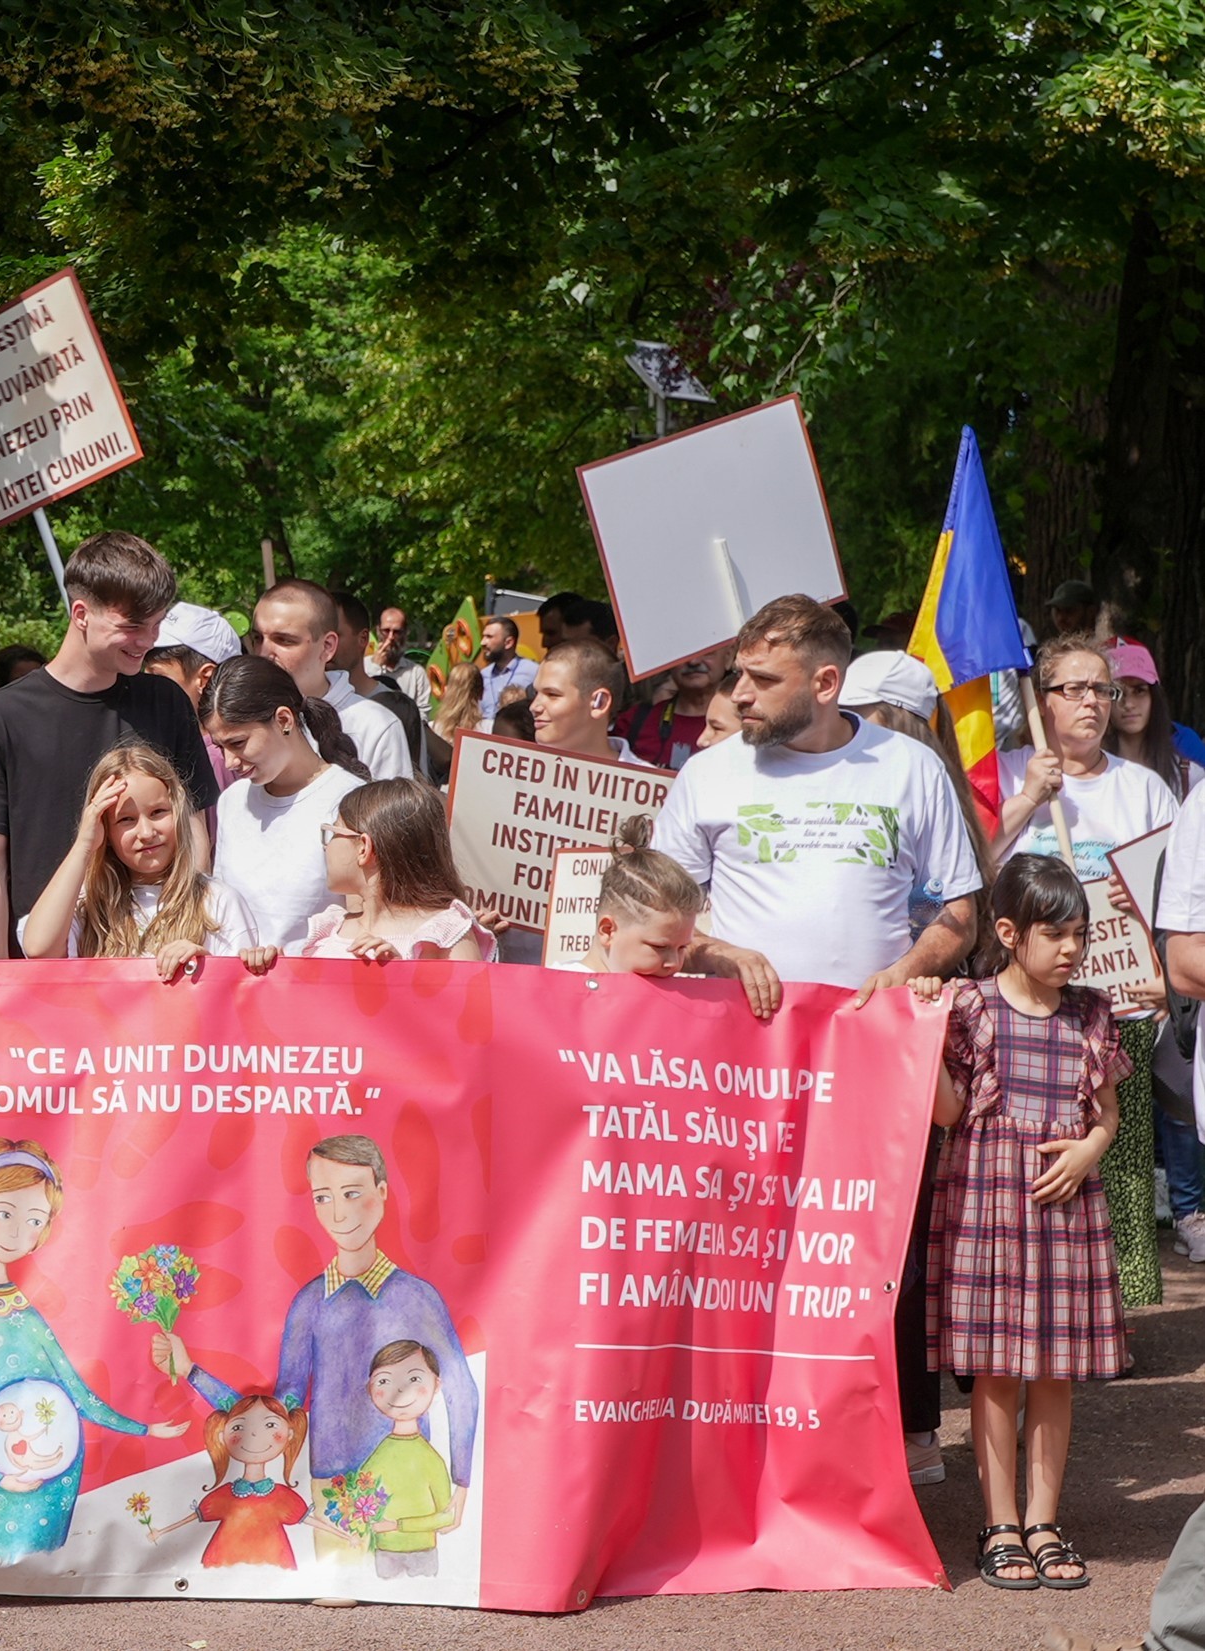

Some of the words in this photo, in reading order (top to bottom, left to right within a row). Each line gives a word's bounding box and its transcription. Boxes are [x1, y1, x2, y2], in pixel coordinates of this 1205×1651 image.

[49, 392, 94, 431] PRIN
[47, 431, 128, 485] CUNUNII.
[482, 749, 545, 783] CRED
[553, 757, 579, 791] ÎN
[587, 770, 667, 809] VIITOR
[513, 792, 618, 835] FAMILIEI
[491, 823, 603, 858] INSTI
[573, 859, 614, 876] CONL
[560, 935, 594, 952] TREB
[1089, 916, 1131, 944] ESTE
[73, 1048, 96, 1075] A
[104, 1045, 174, 1074] UNIT
[184, 1045, 363, 1074] DUMNEZEU
[630, 1049, 708, 1092] LĂSA
[715, 1062, 793, 1100] OMUL
[794, 1069, 834, 1103] PE
[92, 1079, 128, 1114] SĂ
[137, 1083, 180, 1113] NU
[582, 1101, 677, 1142] TATĂL
[685, 1106, 737, 1147] SĂU
[581, 1160, 687, 1198] MAMA
[695, 1166, 722, 1200] SA
[782, 1177, 824, 1209] VA
[831, 1179, 875, 1212] LIPI
[579, 1216, 625, 1250] DE
[635, 1219, 725, 1256] FEMEIA
[729, 1226, 758, 1259] SA
[796, 1232, 854, 1265] VOR
[579, 1273, 608, 1306] FI
[618, 1270, 735, 1311] AMÂNDOI
[740, 1281, 774, 1313] UN
[682, 1398, 731, 1424] DUPĂ
[775, 1407, 803, 1431] 19,
[808, 1409, 820, 1430] 5
